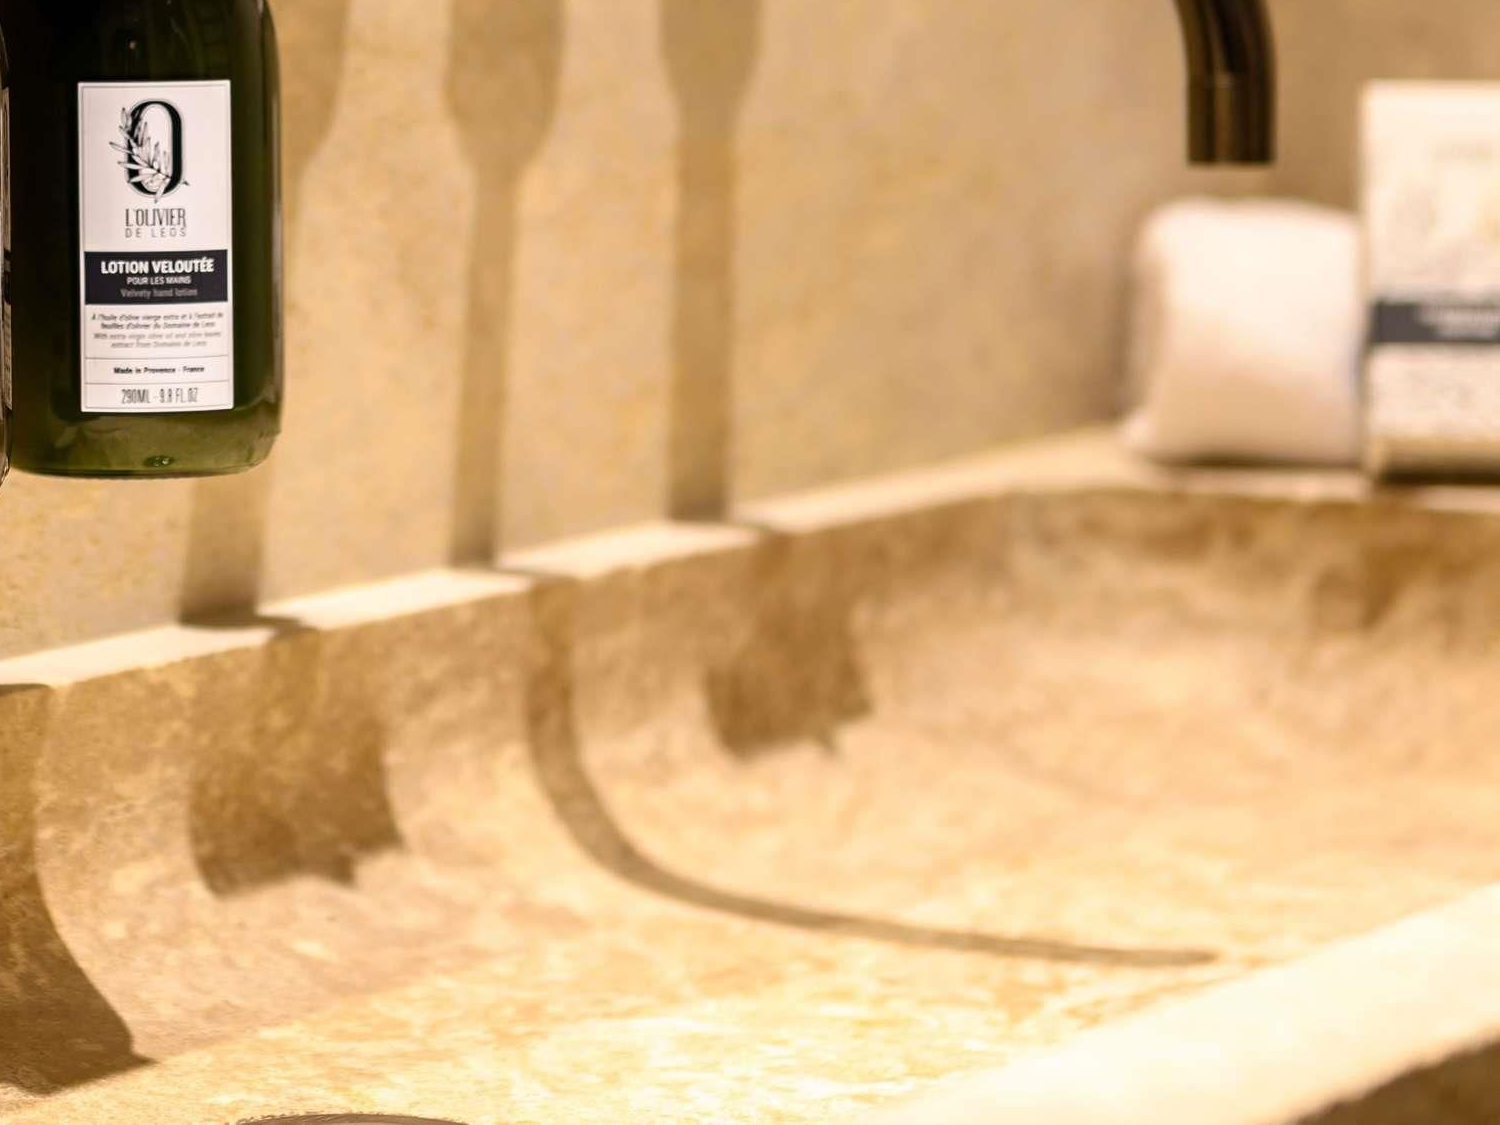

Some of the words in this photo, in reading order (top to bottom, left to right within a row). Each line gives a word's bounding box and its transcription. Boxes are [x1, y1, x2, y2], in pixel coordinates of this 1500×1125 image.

[125, 208, 186, 227] L'OLIVIER
[125, 228, 141, 238] DE
[152, 227, 186, 237] LEOS
[101, 261, 148, 274] LOTION
[152, 257, 214, 273] VELOUTÉE
[127, 277, 148, 285] POUR
[166, 276, 191, 284] MAINS
[120, 290, 151, 298] Velvety
[154, 289, 173, 297] hand
[175, 288, 197, 296] lotion
[122, 388, 151, 404] 290ML
